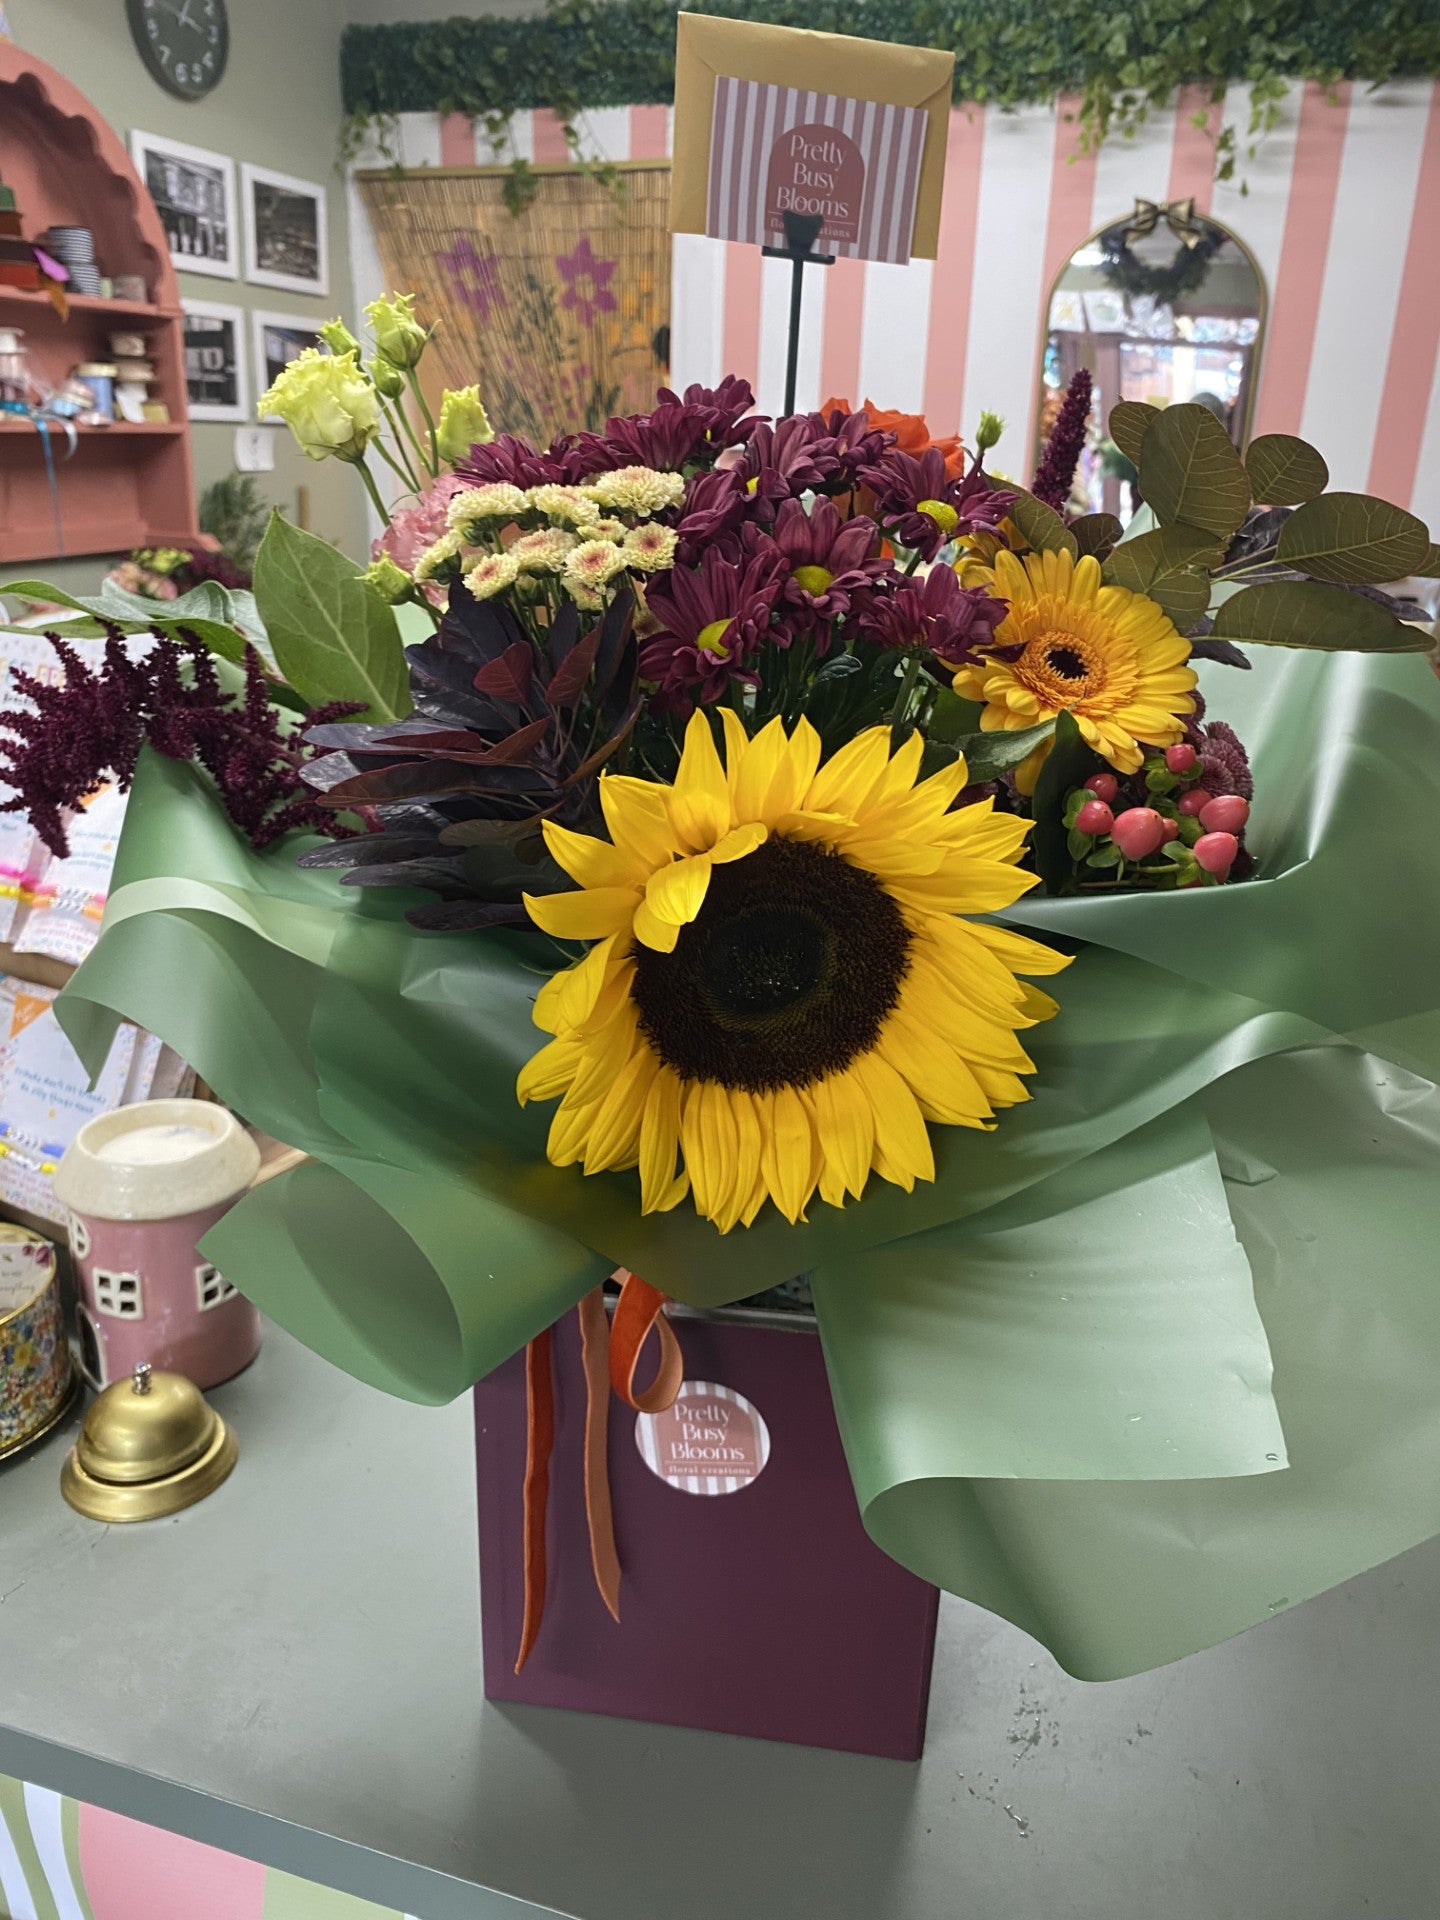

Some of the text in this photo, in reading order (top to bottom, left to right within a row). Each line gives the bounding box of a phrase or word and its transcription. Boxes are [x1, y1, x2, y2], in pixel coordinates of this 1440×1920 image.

[160, 44, 171, 64] 7
[790, 134, 847, 172] Pretty
[793, 162, 838, 197] Busy
[776, 186, 849, 218] Blooms
[674, 1403, 731, 1427] Pretty
[682, 1423, 727, 1446] Busy
[671, 1442, 745, 1461] Blooms
[668, 1464, 751, 1475] floral creations
